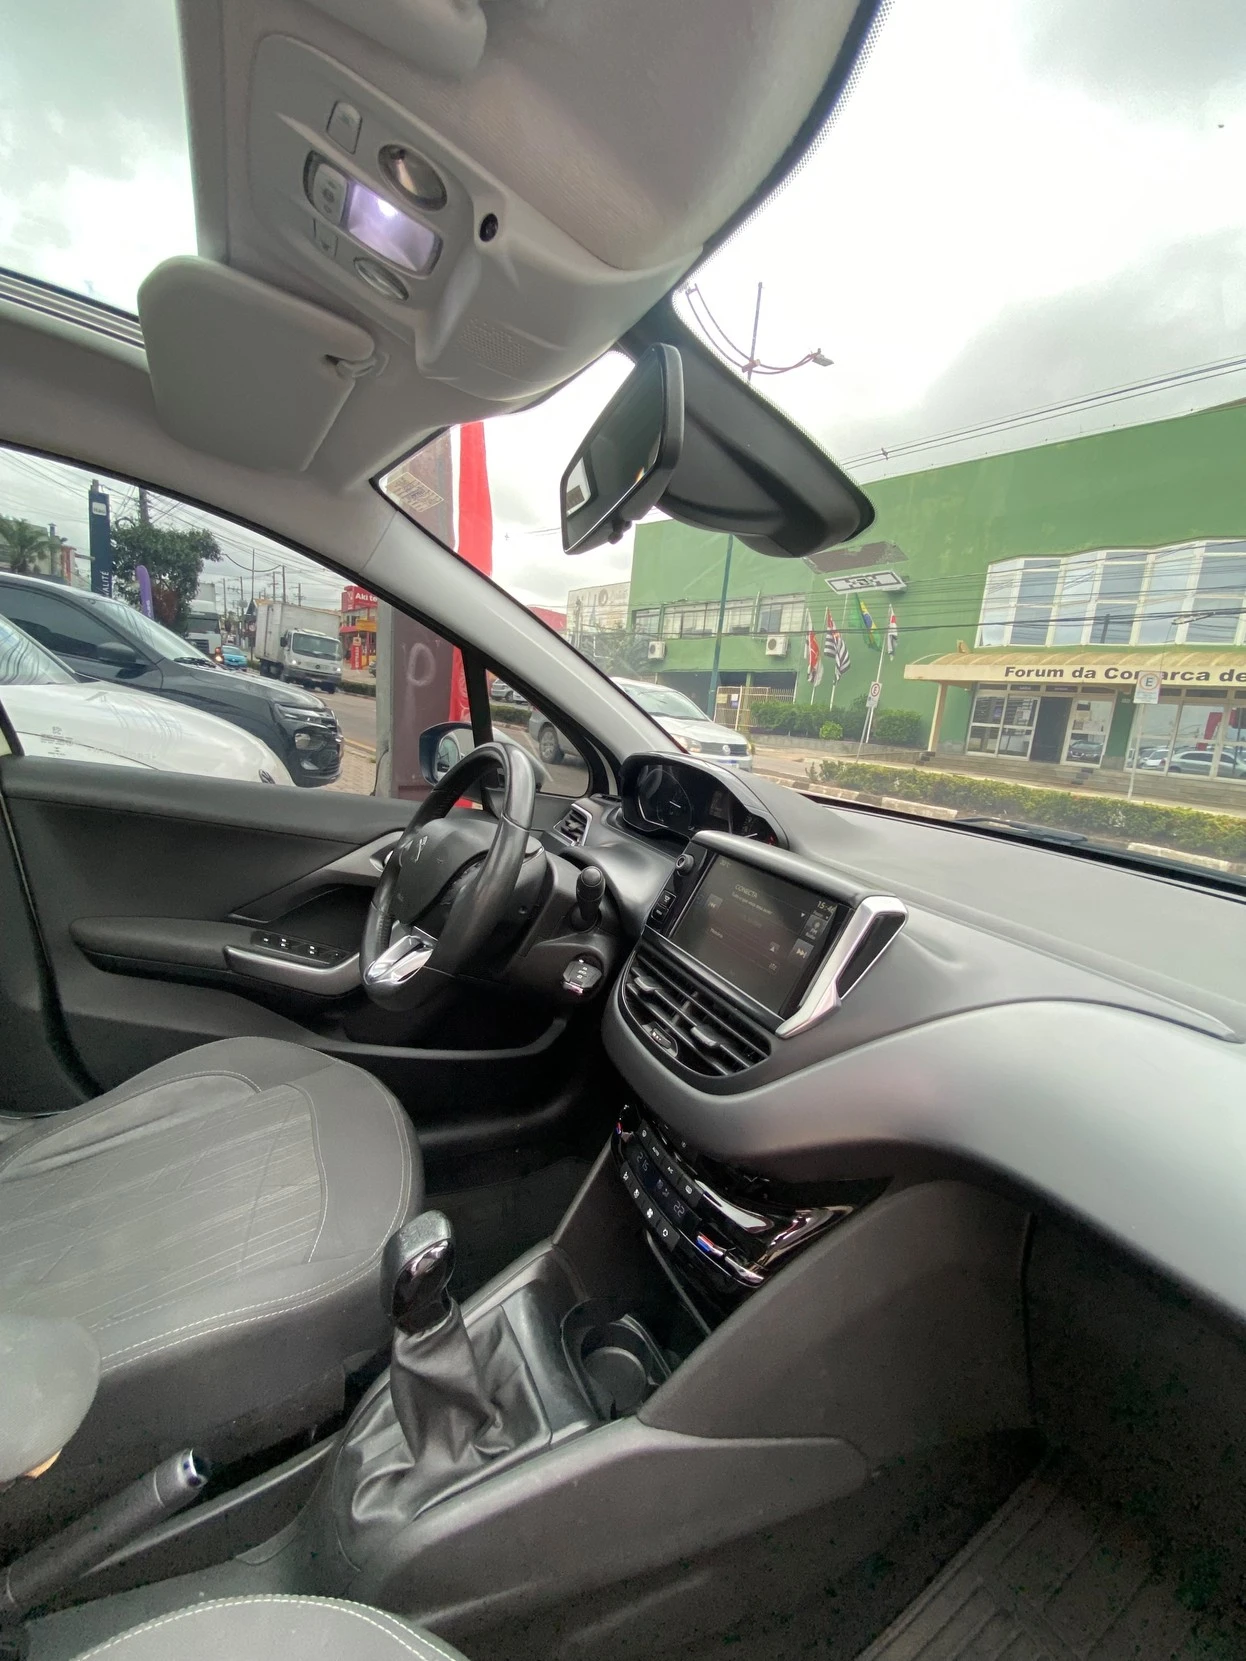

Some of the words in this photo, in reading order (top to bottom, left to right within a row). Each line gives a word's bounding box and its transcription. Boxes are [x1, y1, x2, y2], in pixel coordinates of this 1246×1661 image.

[355, 592, 369, 601] Aki
[1004, 666, 1064, 678] Forum
[1071, 666, 1096, 679] da
[1104, 667, 1210, 681] Coarca
[1219, 668, 1246, 682] de
[1145, 677, 1154, 687] E
[673, 1200, 685, 1218] 22
